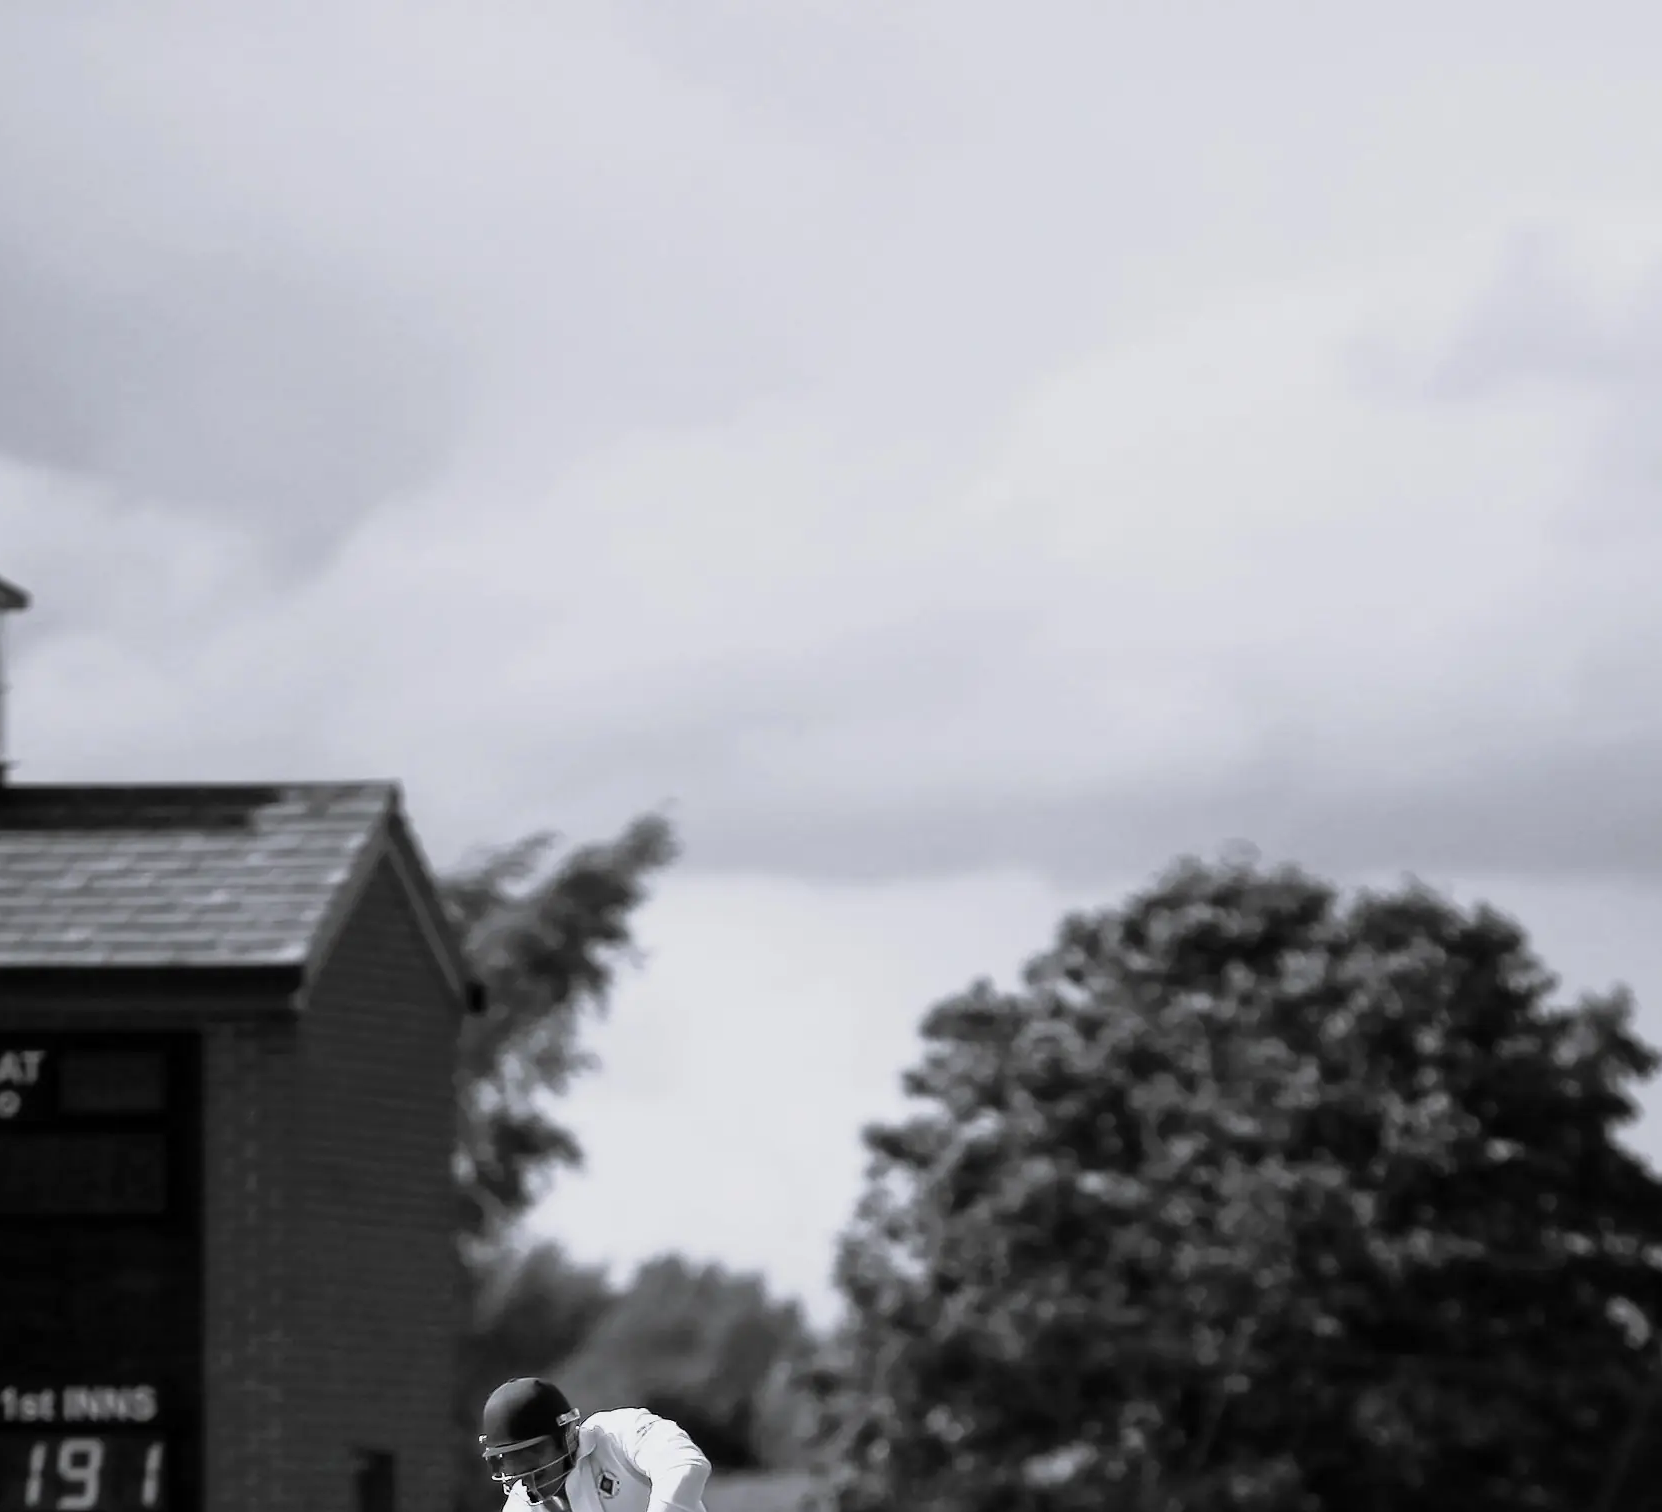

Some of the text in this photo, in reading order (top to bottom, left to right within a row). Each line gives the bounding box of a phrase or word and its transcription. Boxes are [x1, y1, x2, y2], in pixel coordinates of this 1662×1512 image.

[0, 1386, 157, 1421] 1st INNS
[25, 1438, 163, 1512] 191
